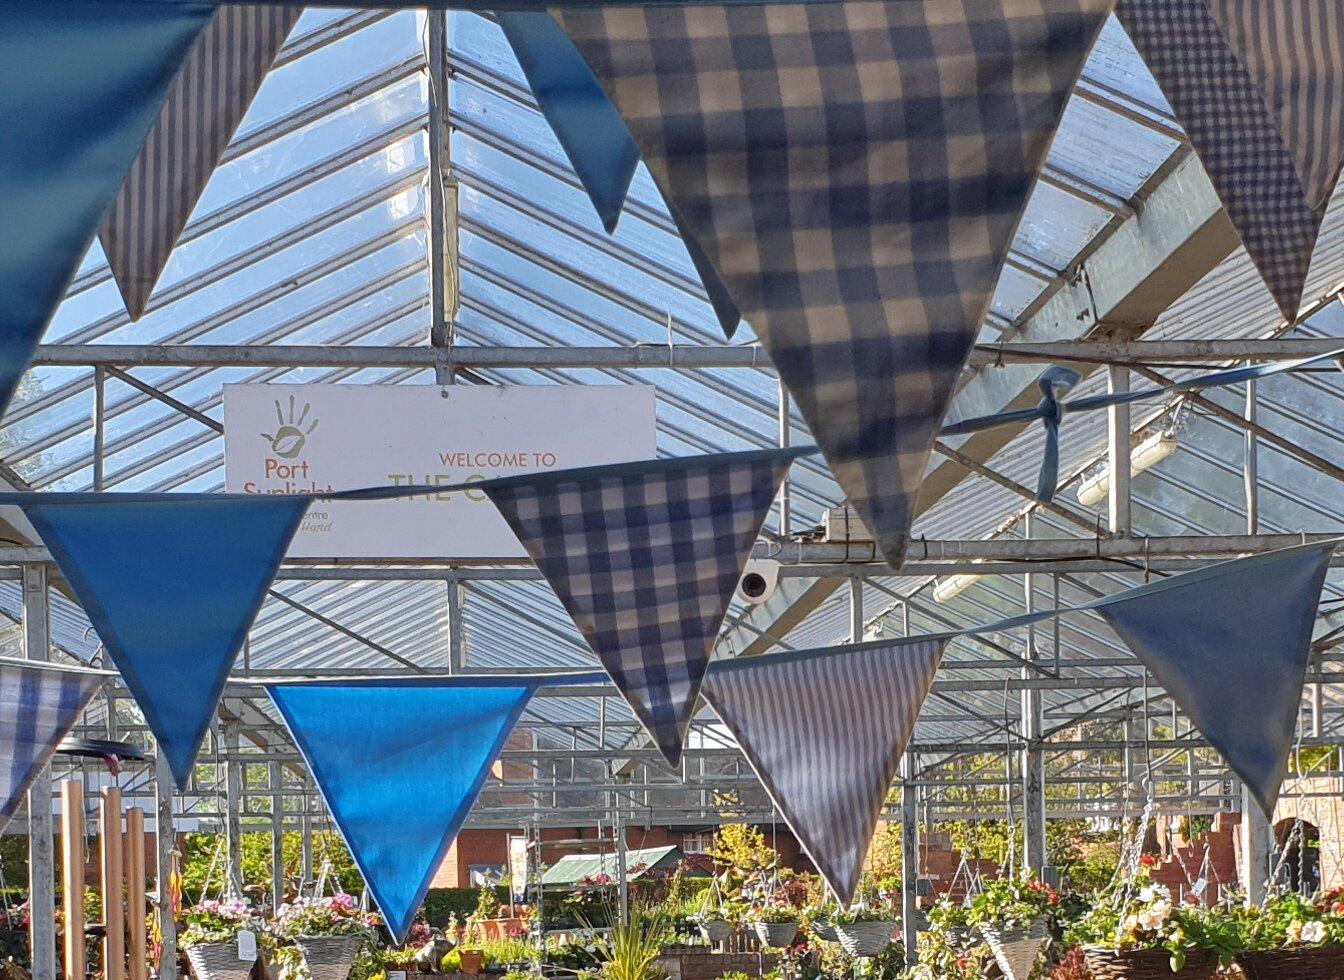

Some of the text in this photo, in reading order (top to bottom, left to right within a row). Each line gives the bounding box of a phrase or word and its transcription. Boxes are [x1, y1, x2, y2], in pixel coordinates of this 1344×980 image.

[265, 458, 309, 479] Port
[438, 452, 556, 468] WELCOME TO
[388, 474, 451, 501] THE
[303, 512, 328, 520] entre
